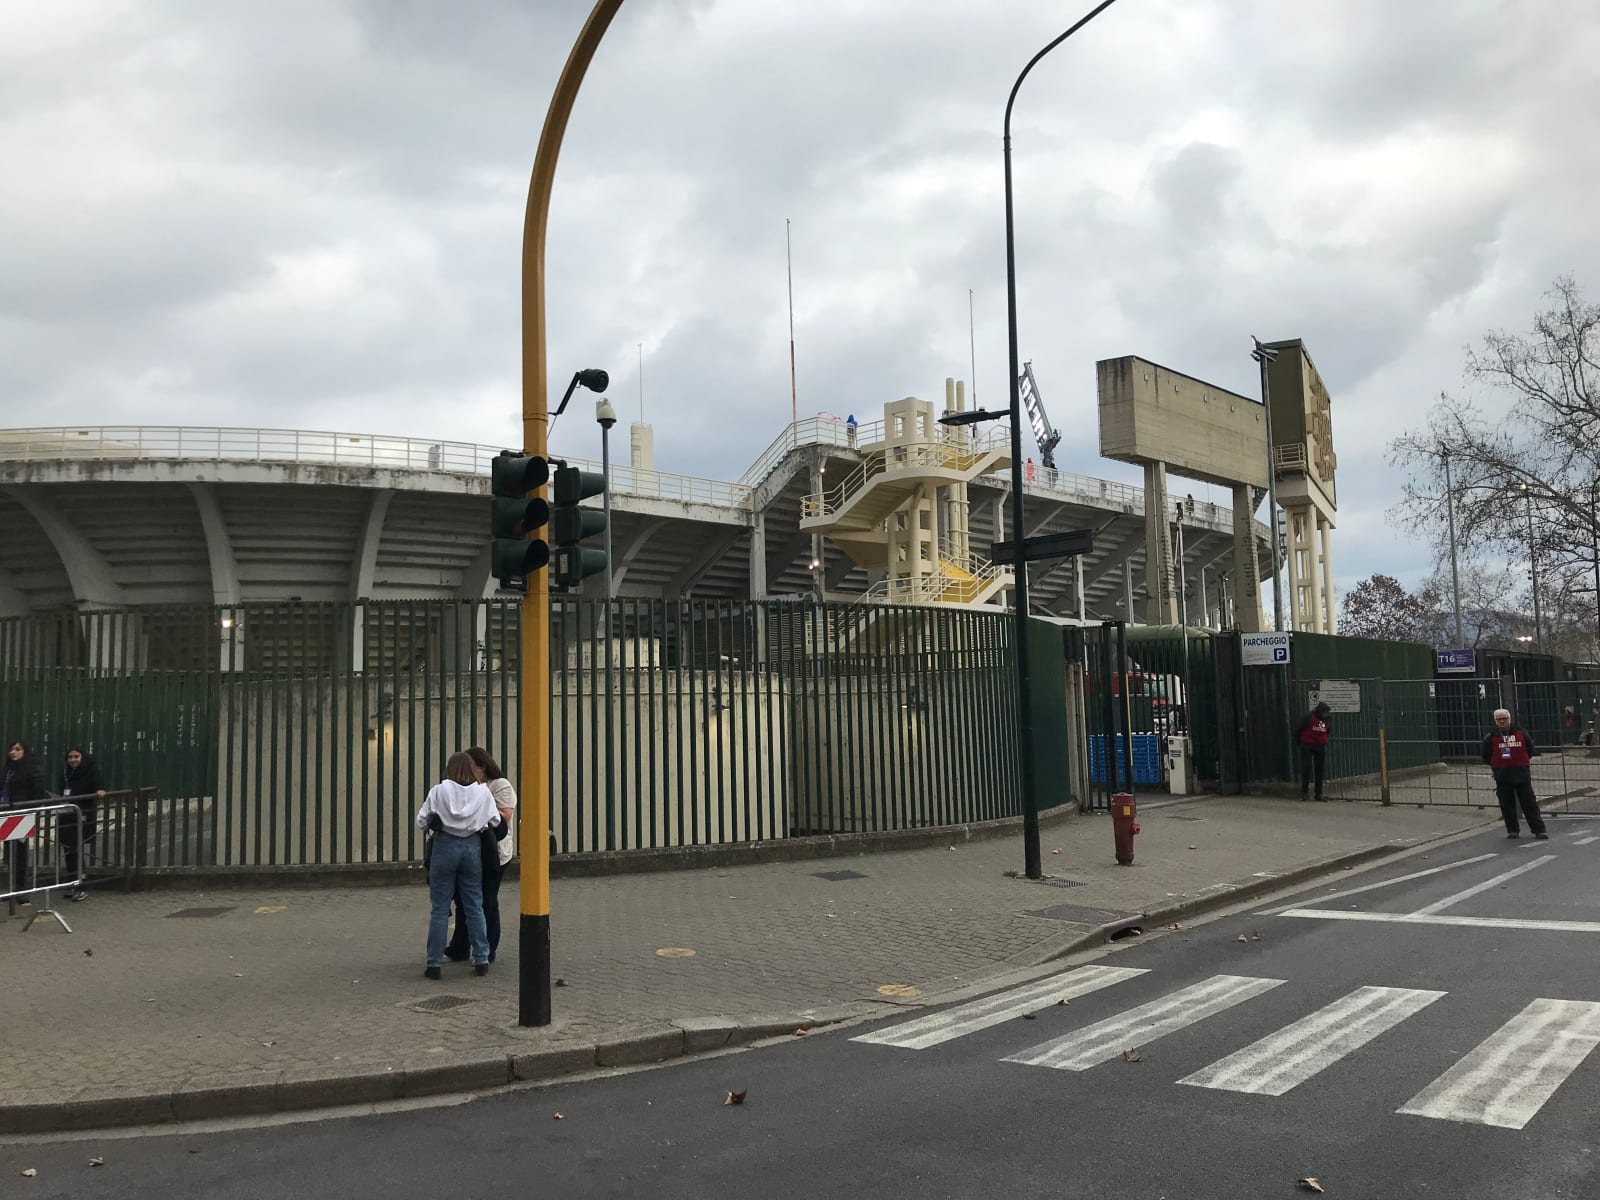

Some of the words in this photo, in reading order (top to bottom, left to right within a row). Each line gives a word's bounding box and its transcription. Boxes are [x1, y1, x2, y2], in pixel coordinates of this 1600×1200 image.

[1243, 636, 1287, 647] PARCHEGGIO
[1276, 649, 1285, 660] P
[1438, 655, 1455, 663] T16
